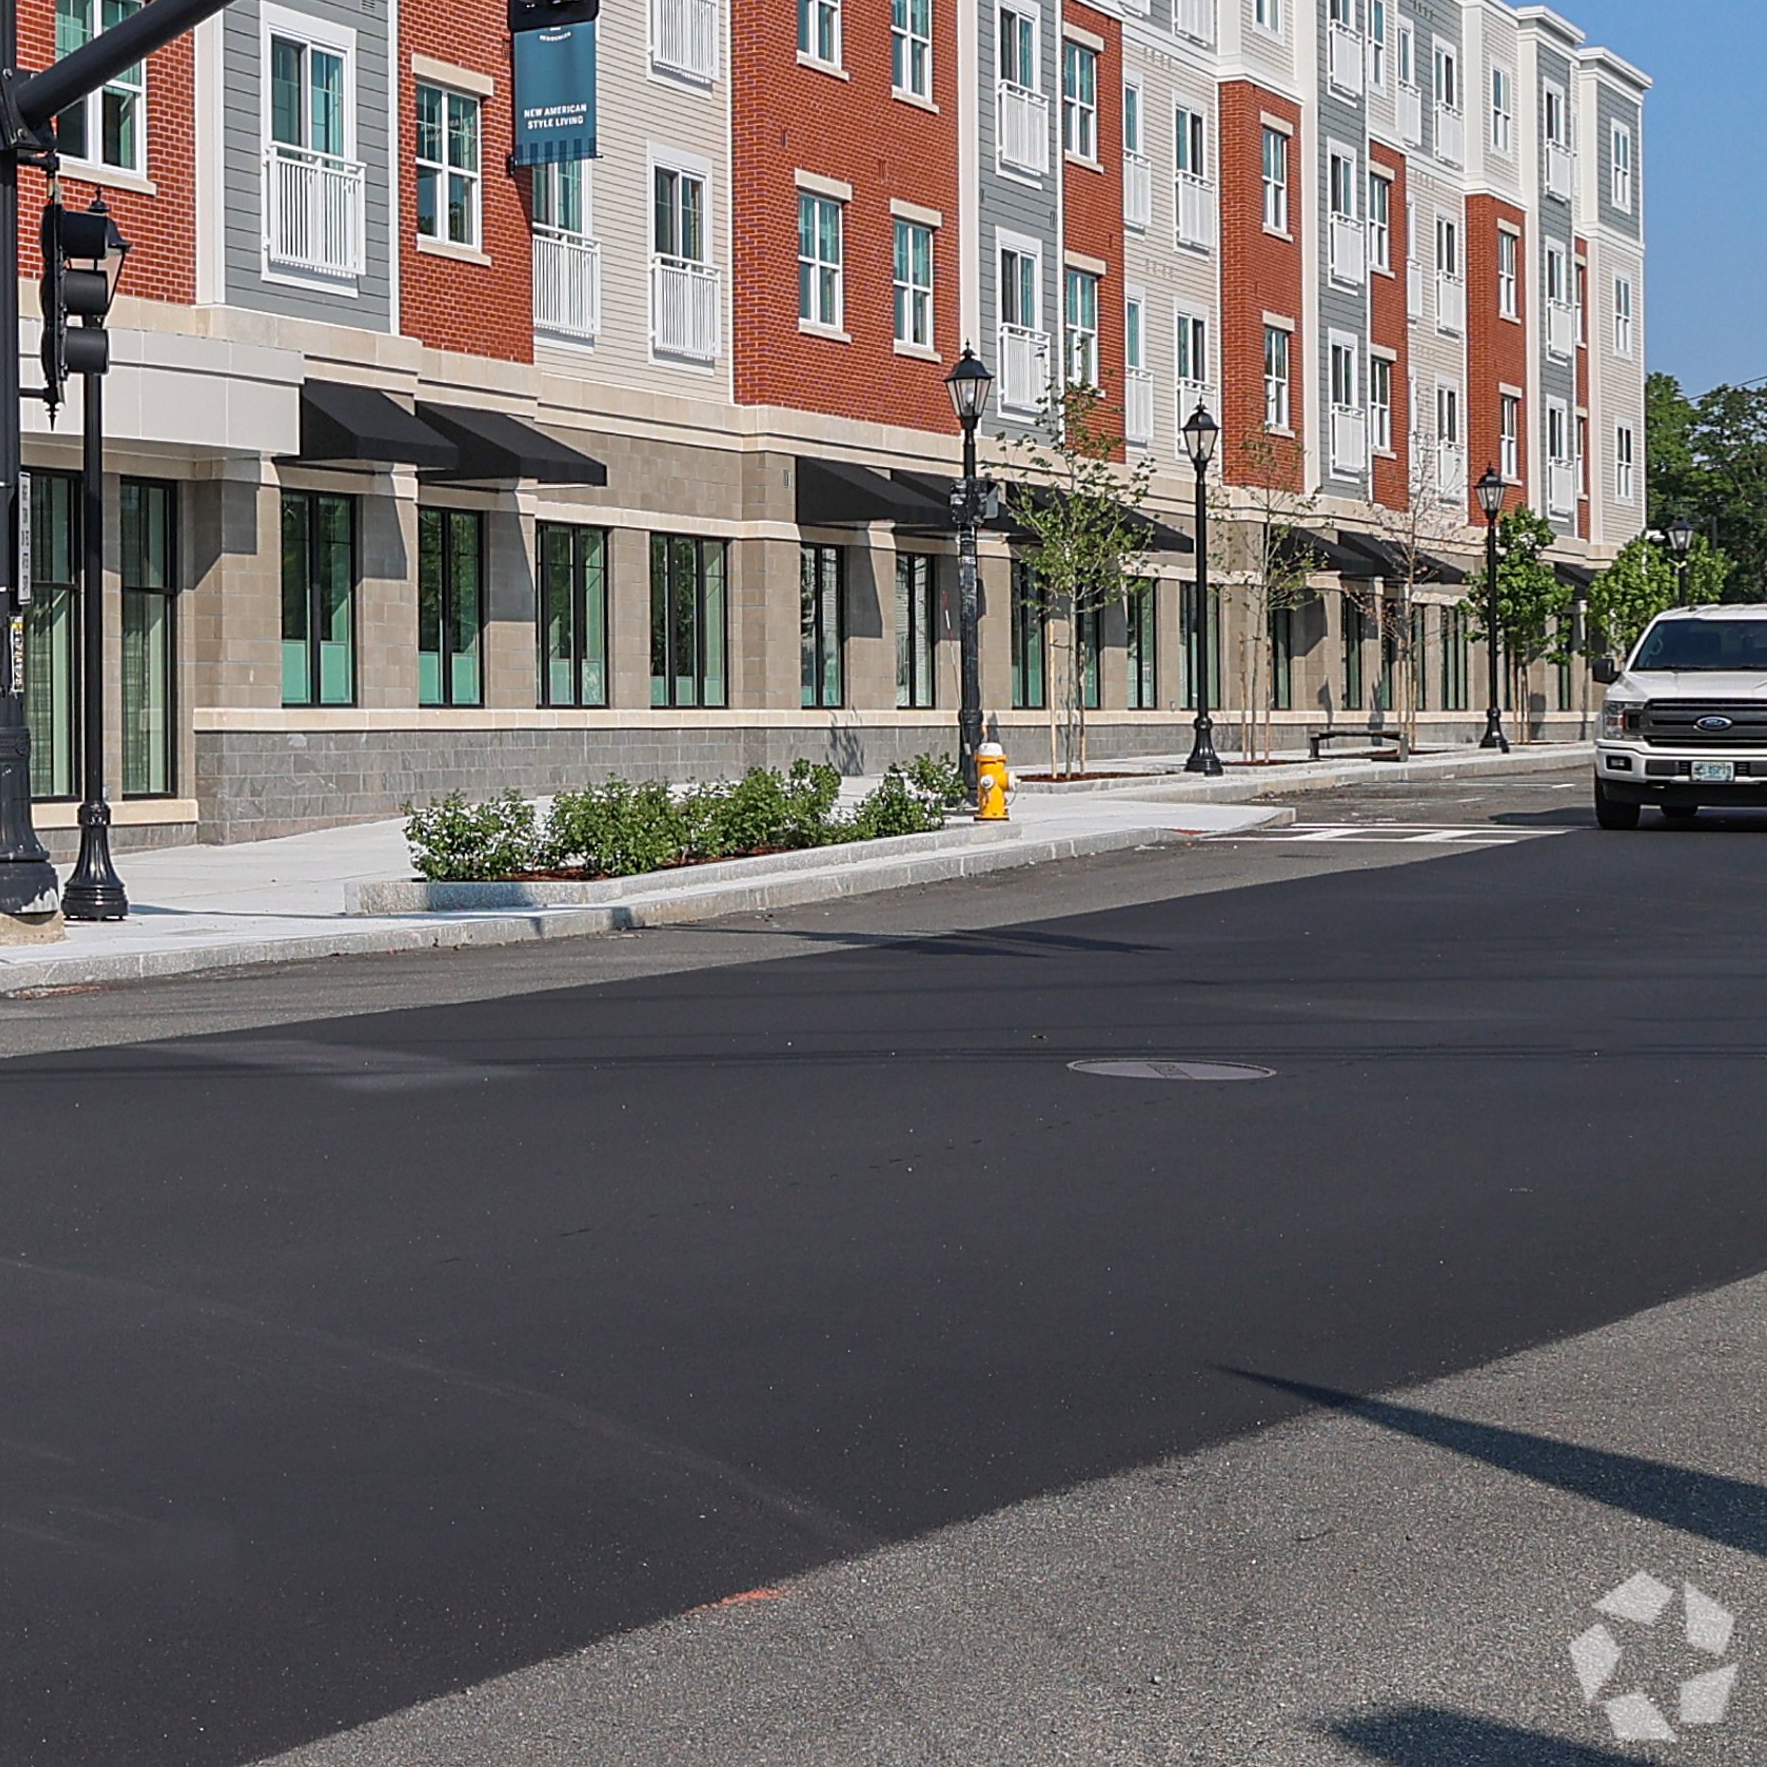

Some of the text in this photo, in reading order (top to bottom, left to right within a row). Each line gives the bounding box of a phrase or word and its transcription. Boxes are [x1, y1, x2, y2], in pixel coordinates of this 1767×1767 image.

[523, 103, 587, 119] NEW AMERICAN
[527, 115, 584, 130] STYLE LIVING
